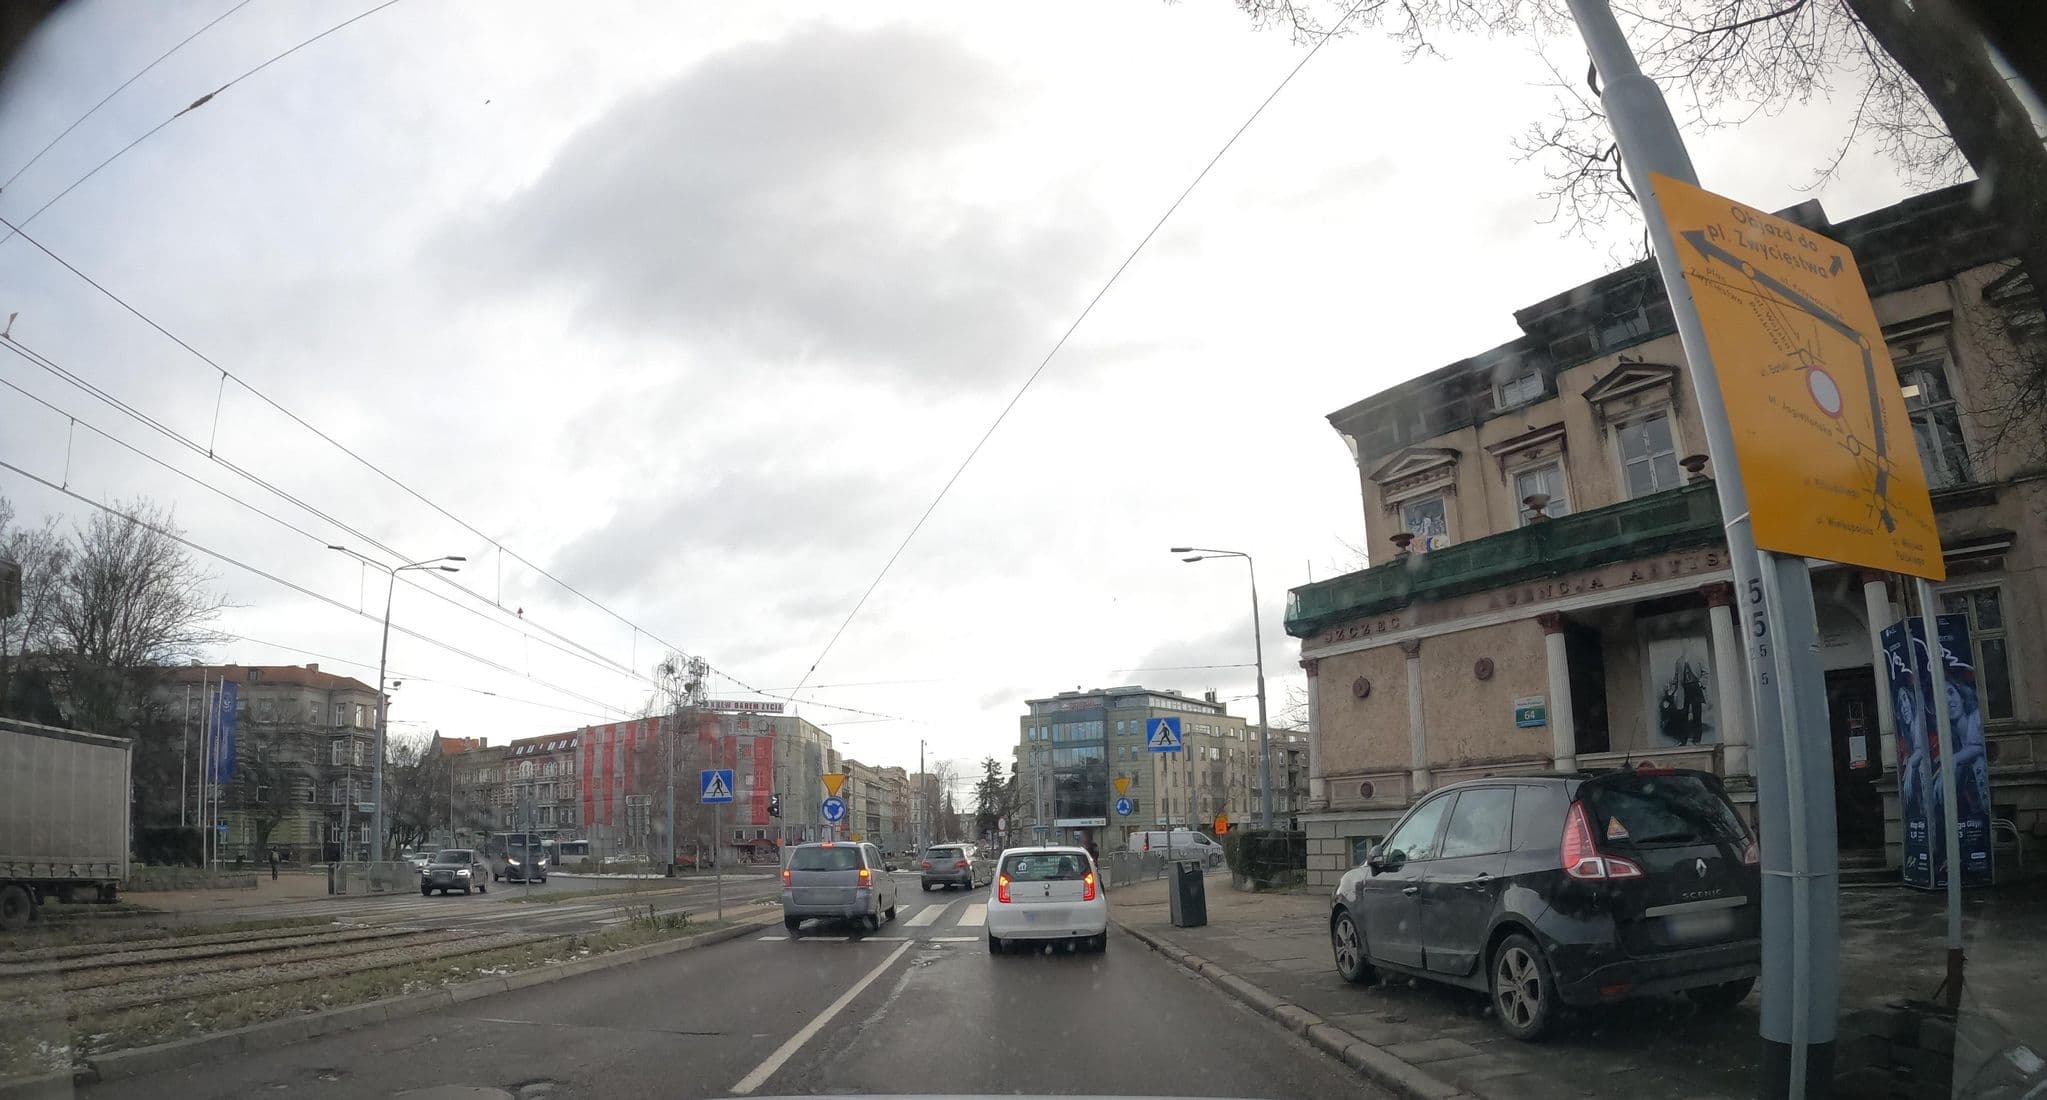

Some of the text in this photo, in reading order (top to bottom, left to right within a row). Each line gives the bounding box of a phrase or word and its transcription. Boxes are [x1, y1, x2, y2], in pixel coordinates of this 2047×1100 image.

[1730, 205, 1819, 252] Objazd do
[1733, 229, 1829, 279] Zwycięstwa
[1748, 578, 1762, 605] 5
[1753, 611, 1767, 638] 5
[1524, 710, 1536, 721] 64
